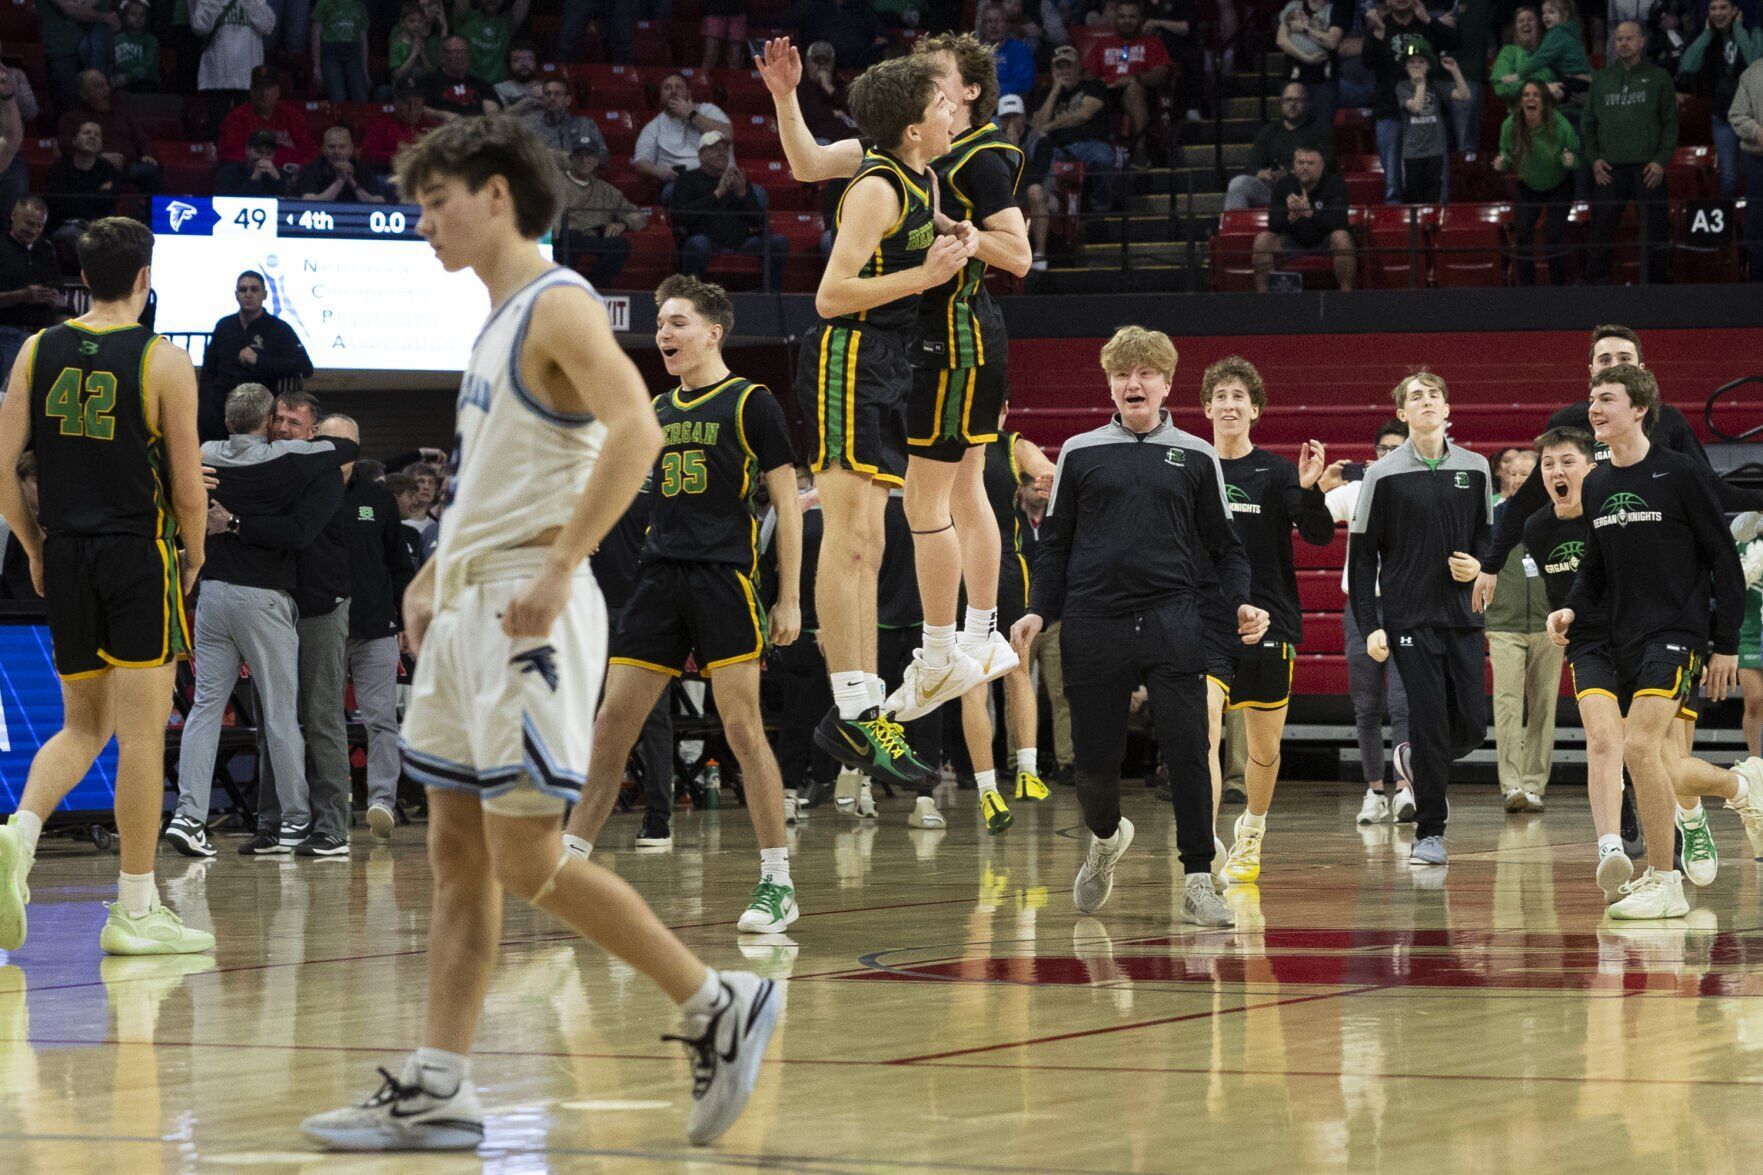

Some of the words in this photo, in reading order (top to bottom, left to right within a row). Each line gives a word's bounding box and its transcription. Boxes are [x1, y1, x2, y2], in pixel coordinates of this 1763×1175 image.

[234, 208, 266, 229] 49
[298, 210, 334, 231] 4th
[369, 211, 406, 233] 0.0
[1691, 208, 1725, 233] A3
[607, 300, 627, 326] IT
[45, 367, 118, 440] 42
[663, 421, 720, 446] ERGAN
[661, 450, 708, 497] 35
[1627, 511, 1663, 522] KNIGHTS
